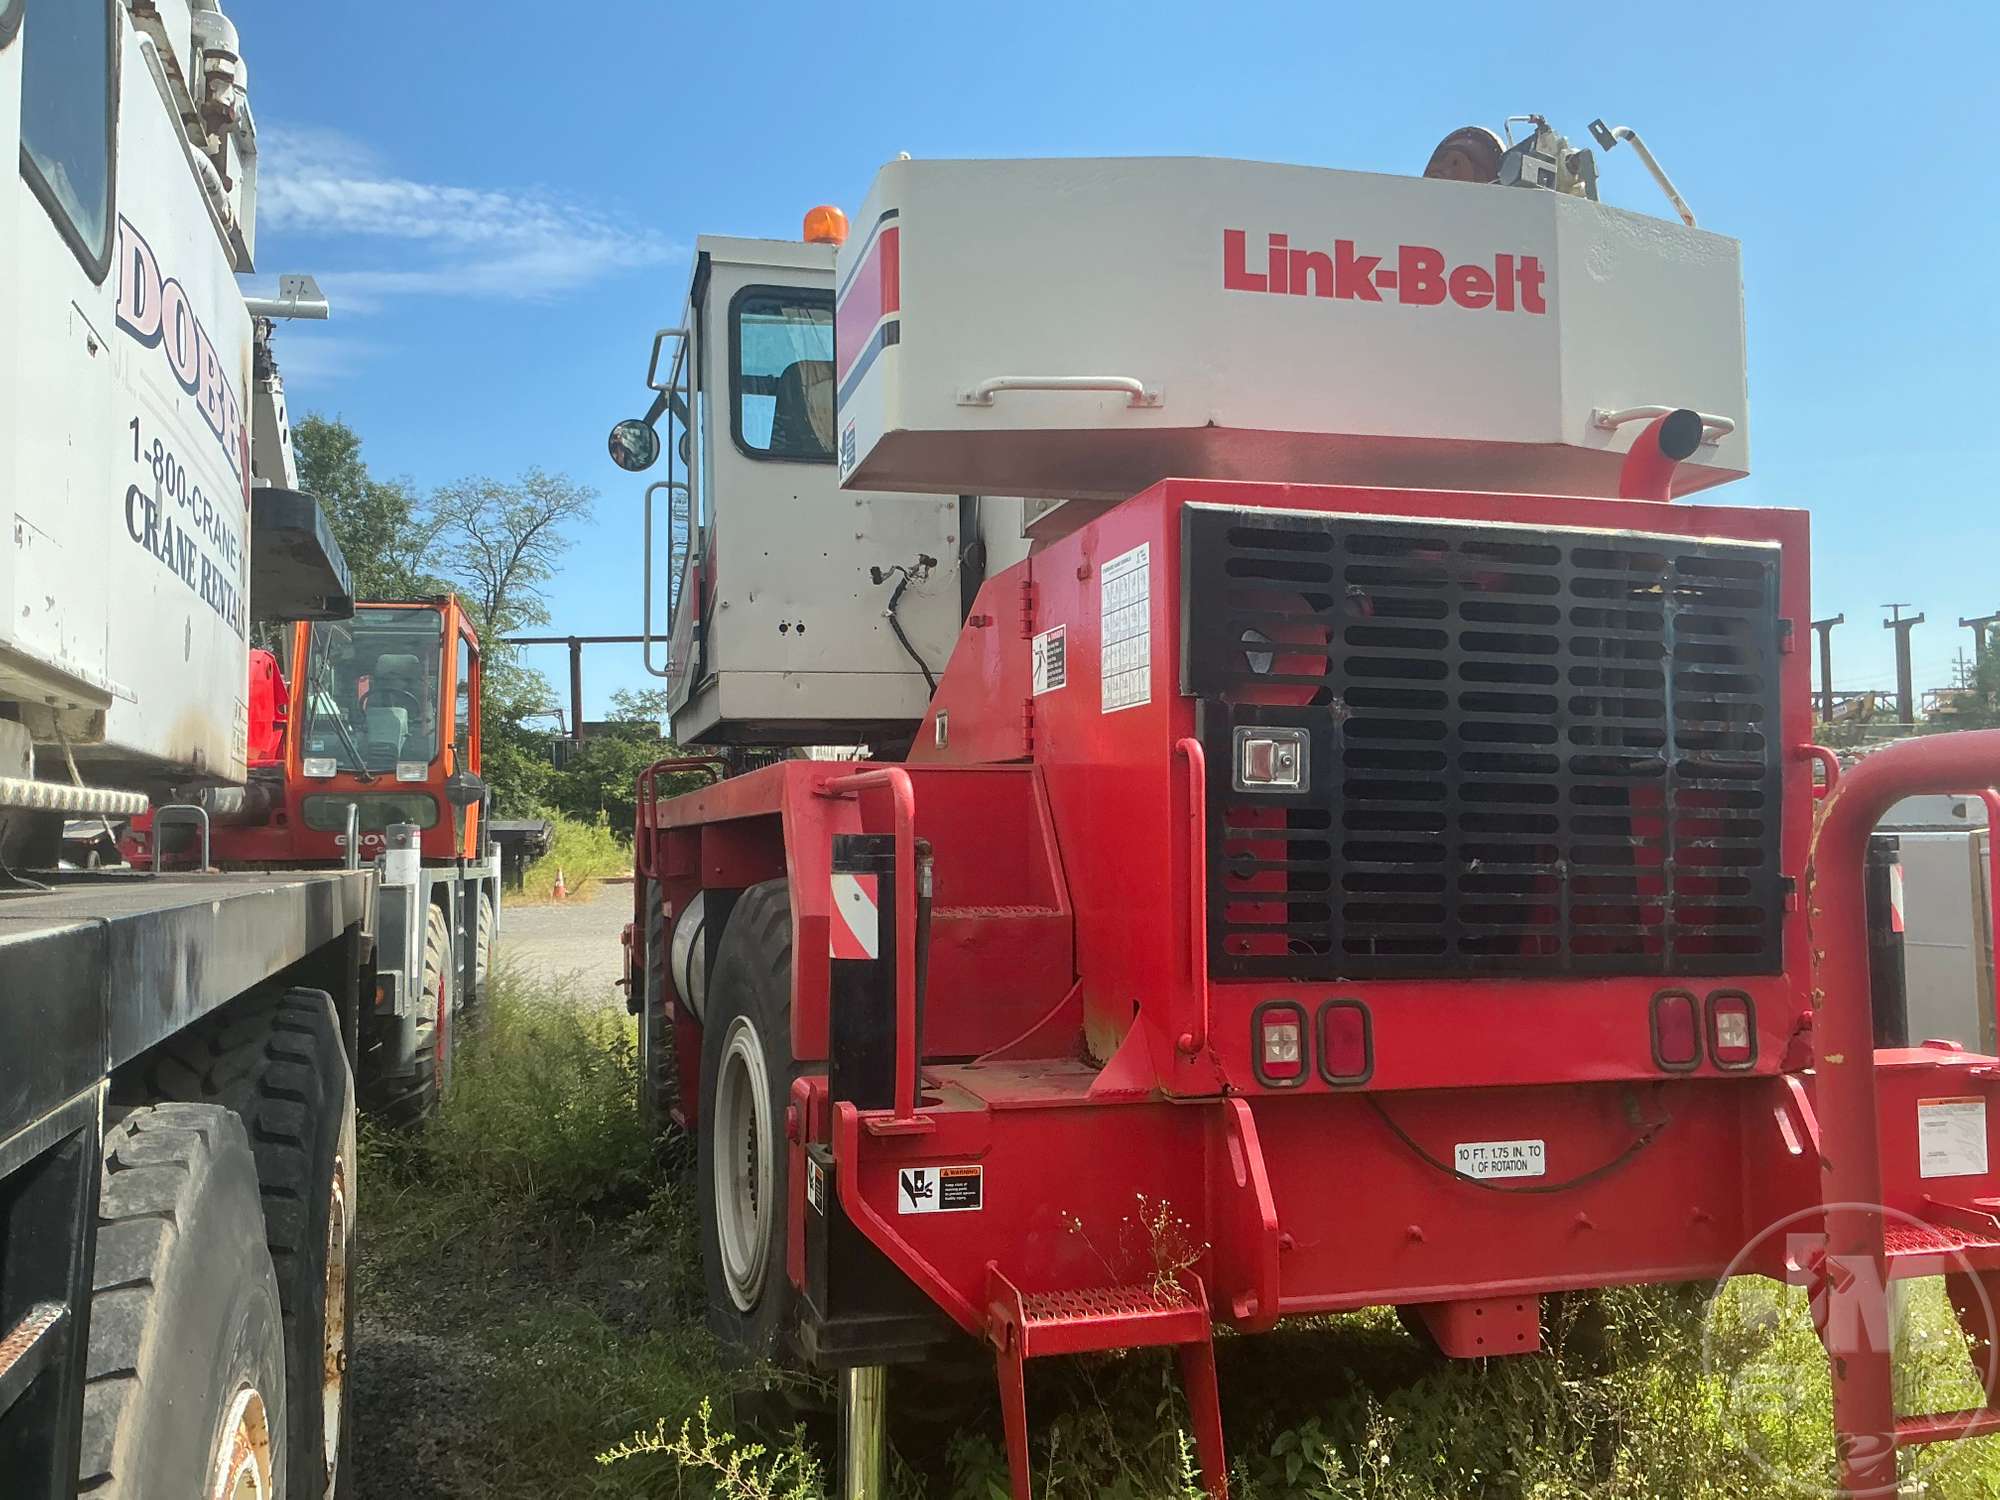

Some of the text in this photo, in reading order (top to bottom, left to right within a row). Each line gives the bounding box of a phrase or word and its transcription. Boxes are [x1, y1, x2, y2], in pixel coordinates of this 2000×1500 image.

[1224, 229, 1546, 315] Link-Belt
[129, 416, 236, 572] 1-800-CRANE
[125, 484, 246, 643] CRANE RENTALS
[1459, 1149, 1470, 1161] 10
[1473, 1148, 1488, 1159] FT.
[1492, 1147, 1509, 1159] 1.75
[1528, 1145, 1541, 1157] TO
[1478, 1161, 1489, 1173] OF
[1491, 1160, 1528, 1172] ROTATION
